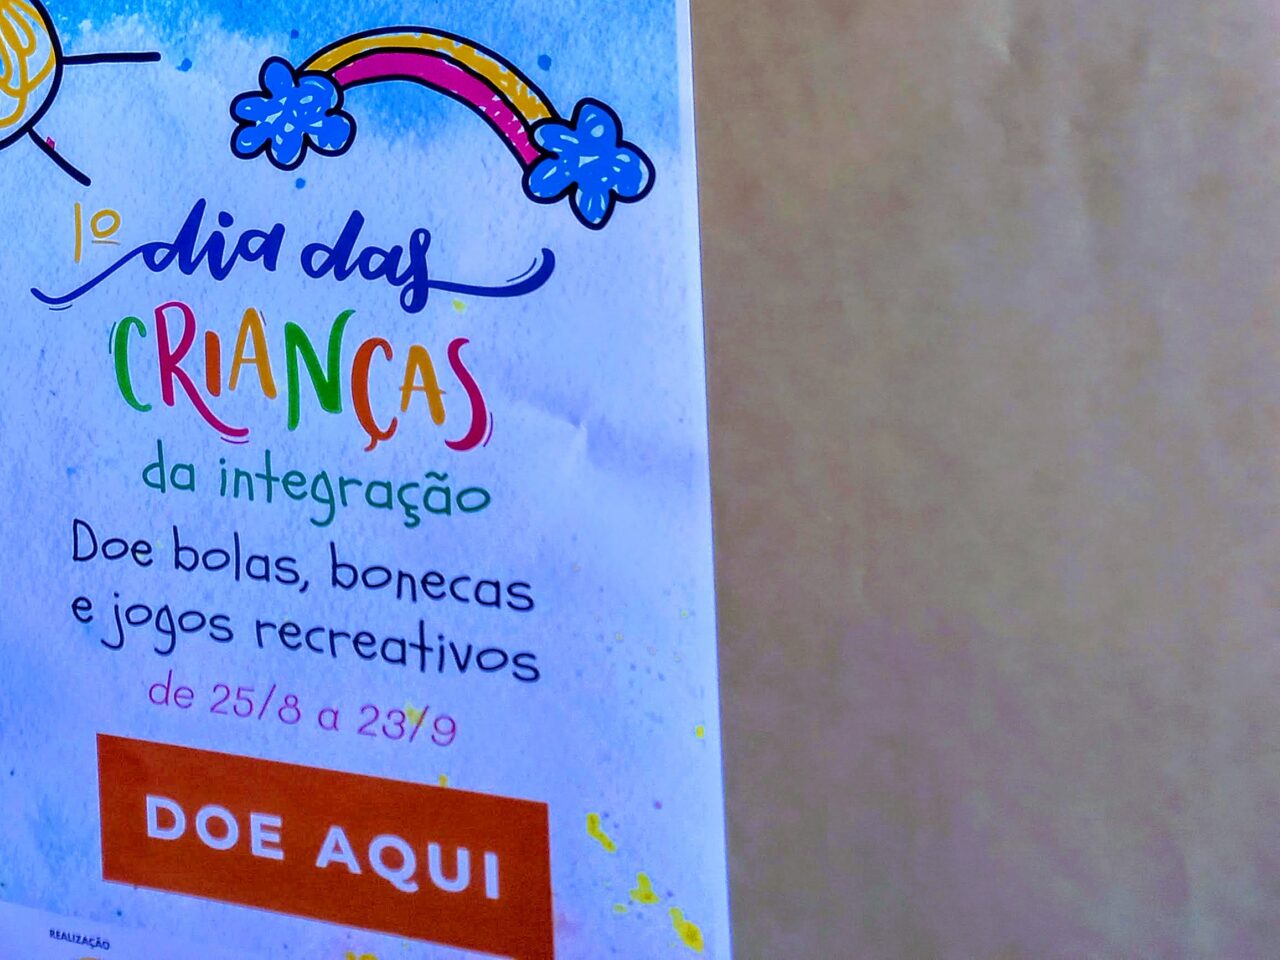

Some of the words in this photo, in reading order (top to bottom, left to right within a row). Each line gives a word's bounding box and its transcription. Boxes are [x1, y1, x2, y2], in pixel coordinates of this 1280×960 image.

[300, 210, 556, 313] das
[108, 301, 493, 452] CRIANÇAS
[142, 440, 195, 494] da
[219, 449, 492, 528] integração
[71, 518, 153, 567] Doe
[173, 525, 310, 594] bolas,
[329, 542, 536, 612] bonecas
[71, 595, 94, 625] e
[101, 593, 234, 655] jogos
[255, 621, 541, 683] recreativos
[148, 670, 194, 711] de
[211, 682, 302, 726] 25/8
[319, 707, 340, 732] a
[358, 703, 458, 747] 23/9
[146, 794, 284, 861] DOE
[315, 825, 501, 900] AQUI
[49, 929, 111, 951] REALIZAÇÃO
